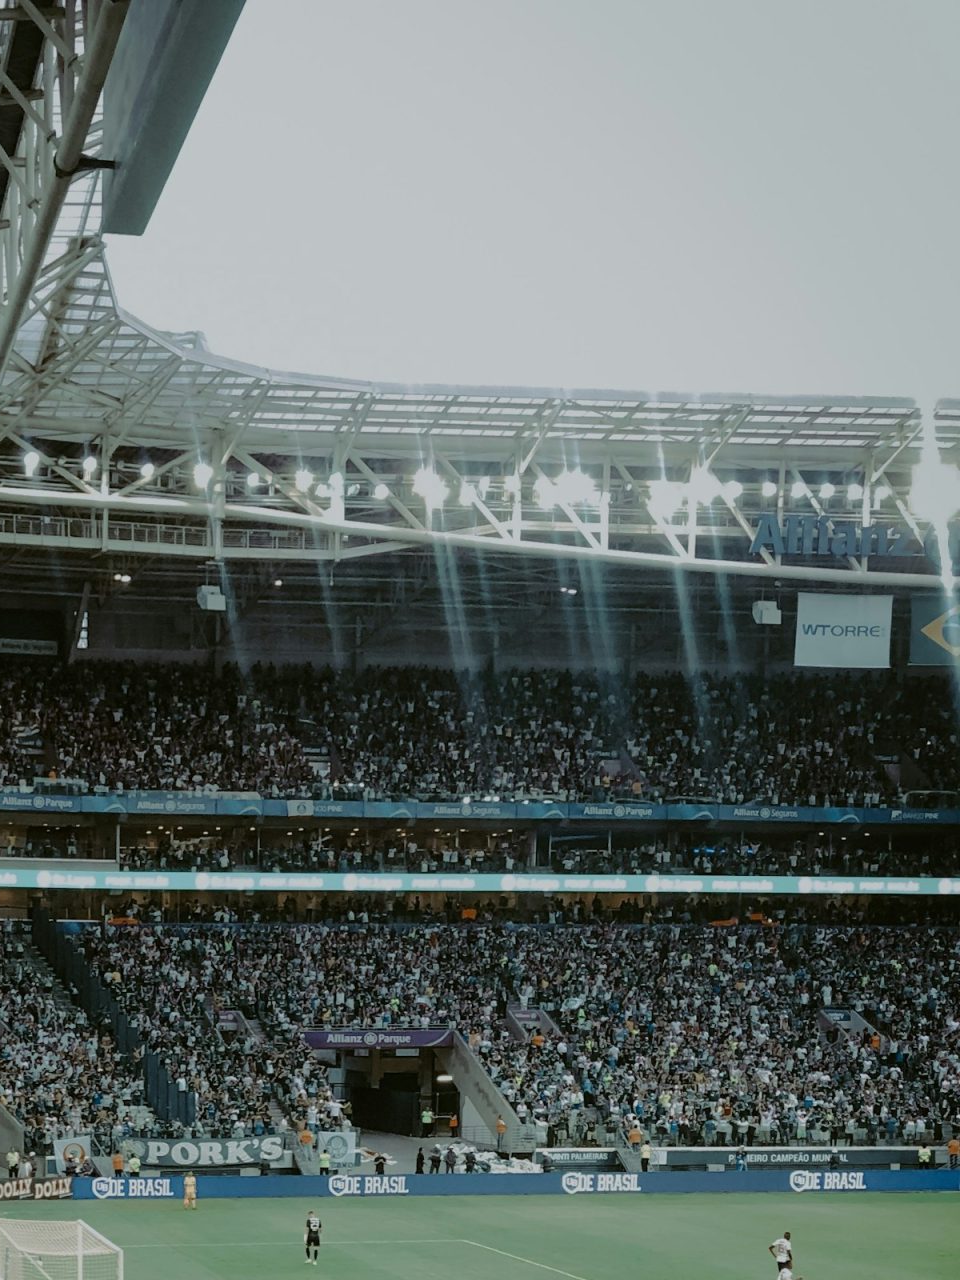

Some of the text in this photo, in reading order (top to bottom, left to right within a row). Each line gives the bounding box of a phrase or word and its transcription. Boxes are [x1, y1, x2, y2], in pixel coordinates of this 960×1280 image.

[802, 623, 881, 638] WTORRE
[2, 796, 73, 809] Allianz Parque
[137, 801, 206, 813] Allianz Seguros
[433, 805, 501, 817] Allianz Seguros
[583, 805, 653, 818] Allianz Parque
[733, 808, 799, 819] Allianz Seguros
[326, 1032, 411, 1045] Allianz Parque
[145, 1136, 283, 1166] PORK'S
[771, 1153, 808, 1163] CAMPEÃO
[35, 1177, 73, 1199] DOLLY
[129, 1178, 174, 1197] BRASIL
[364, 1176, 410, 1194] BRASIL
[597, 1174, 642, 1192] BRASIL
[824, 1172, 867, 1190] BRASIL
